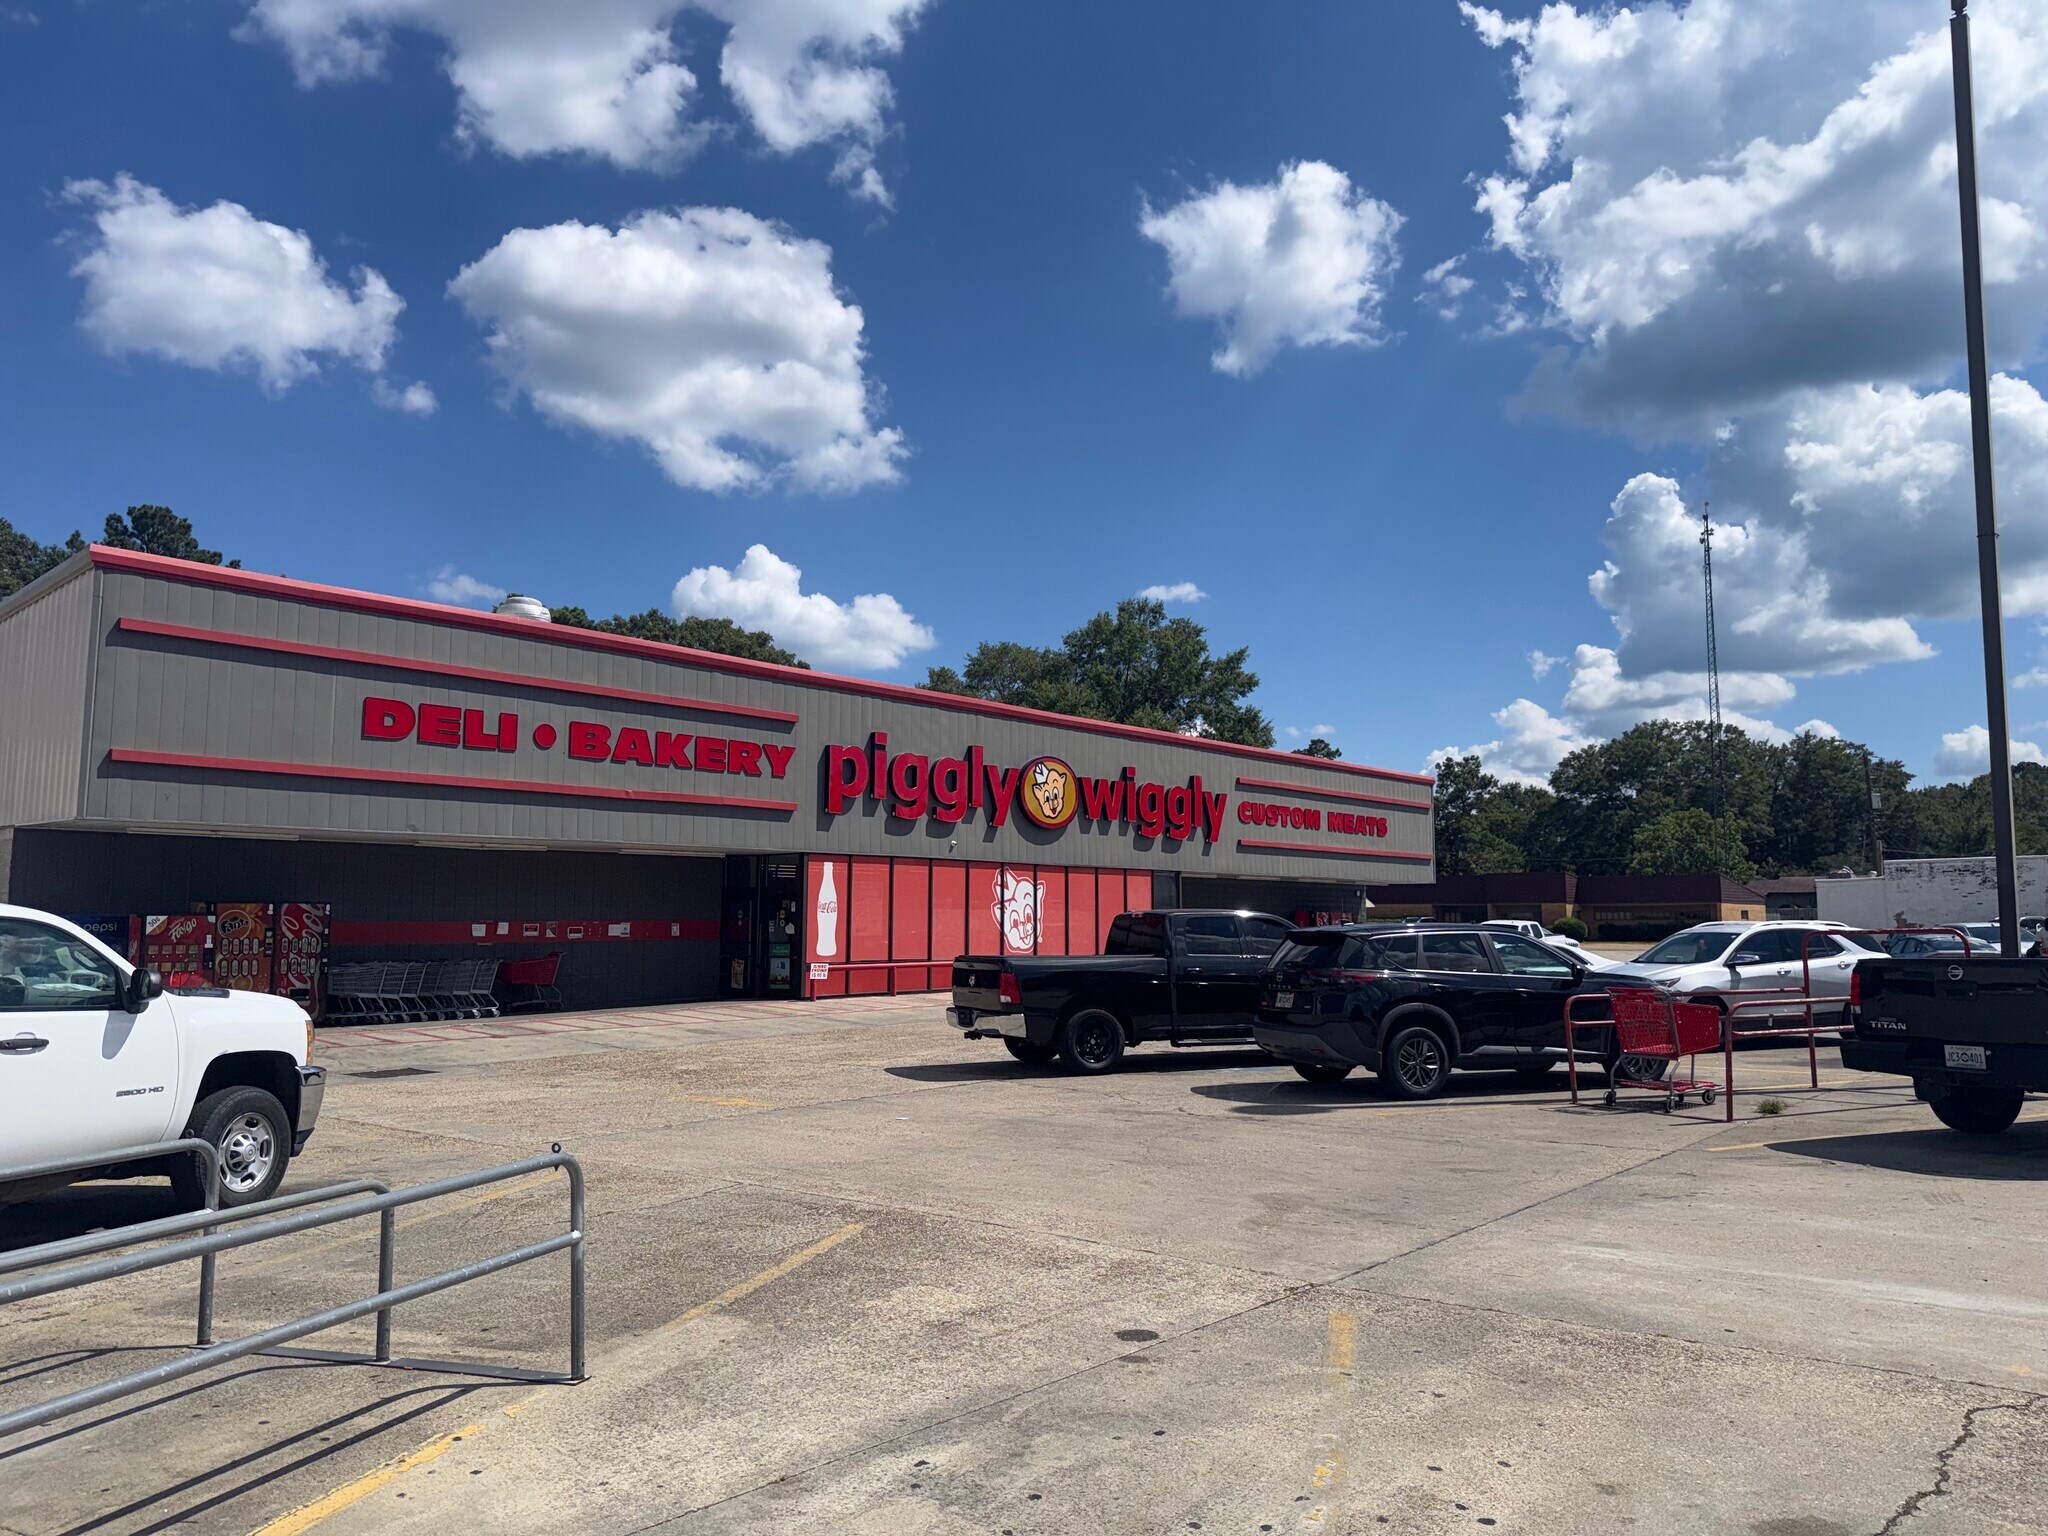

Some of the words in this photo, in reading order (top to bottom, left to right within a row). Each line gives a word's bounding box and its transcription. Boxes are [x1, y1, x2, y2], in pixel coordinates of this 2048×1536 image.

[362, 696, 519, 752] DELI
[567, 720, 797, 778] BAKERY
[825, 731, 1020, 827] piggly
[1077, 766, 1228, 843] wiggly
[1238, 801, 1321, 831] CUSTOM
[1327, 811, 1388, 838] MEATS
[168, 918, 197, 943] Faygo
[220, 917, 249, 934] Fanta
[1869, 1020, 1907, 1030] TITAN
